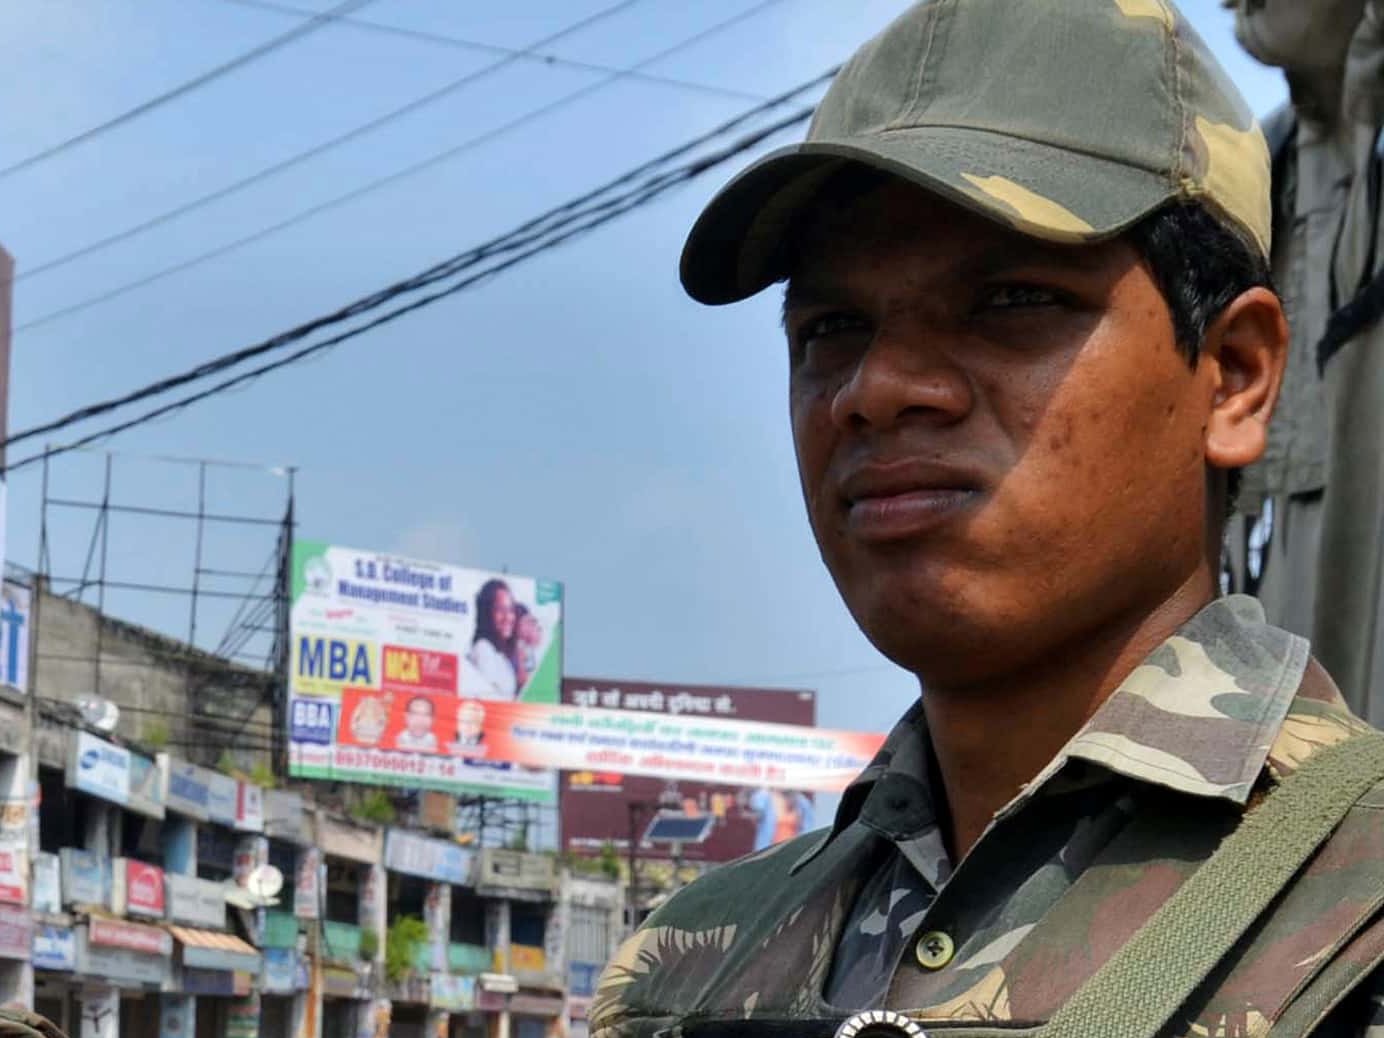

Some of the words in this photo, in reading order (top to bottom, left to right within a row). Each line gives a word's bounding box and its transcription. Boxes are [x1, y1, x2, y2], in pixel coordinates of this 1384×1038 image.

[383, 562, 434, 590] College
[439, 574, 452, 590] of
[338, 579, 420, 606] Management
[423, 591, 469, 615] Studies
[299, 636, 372, 684] MBA
[293, 700, 332, 728] BBA
